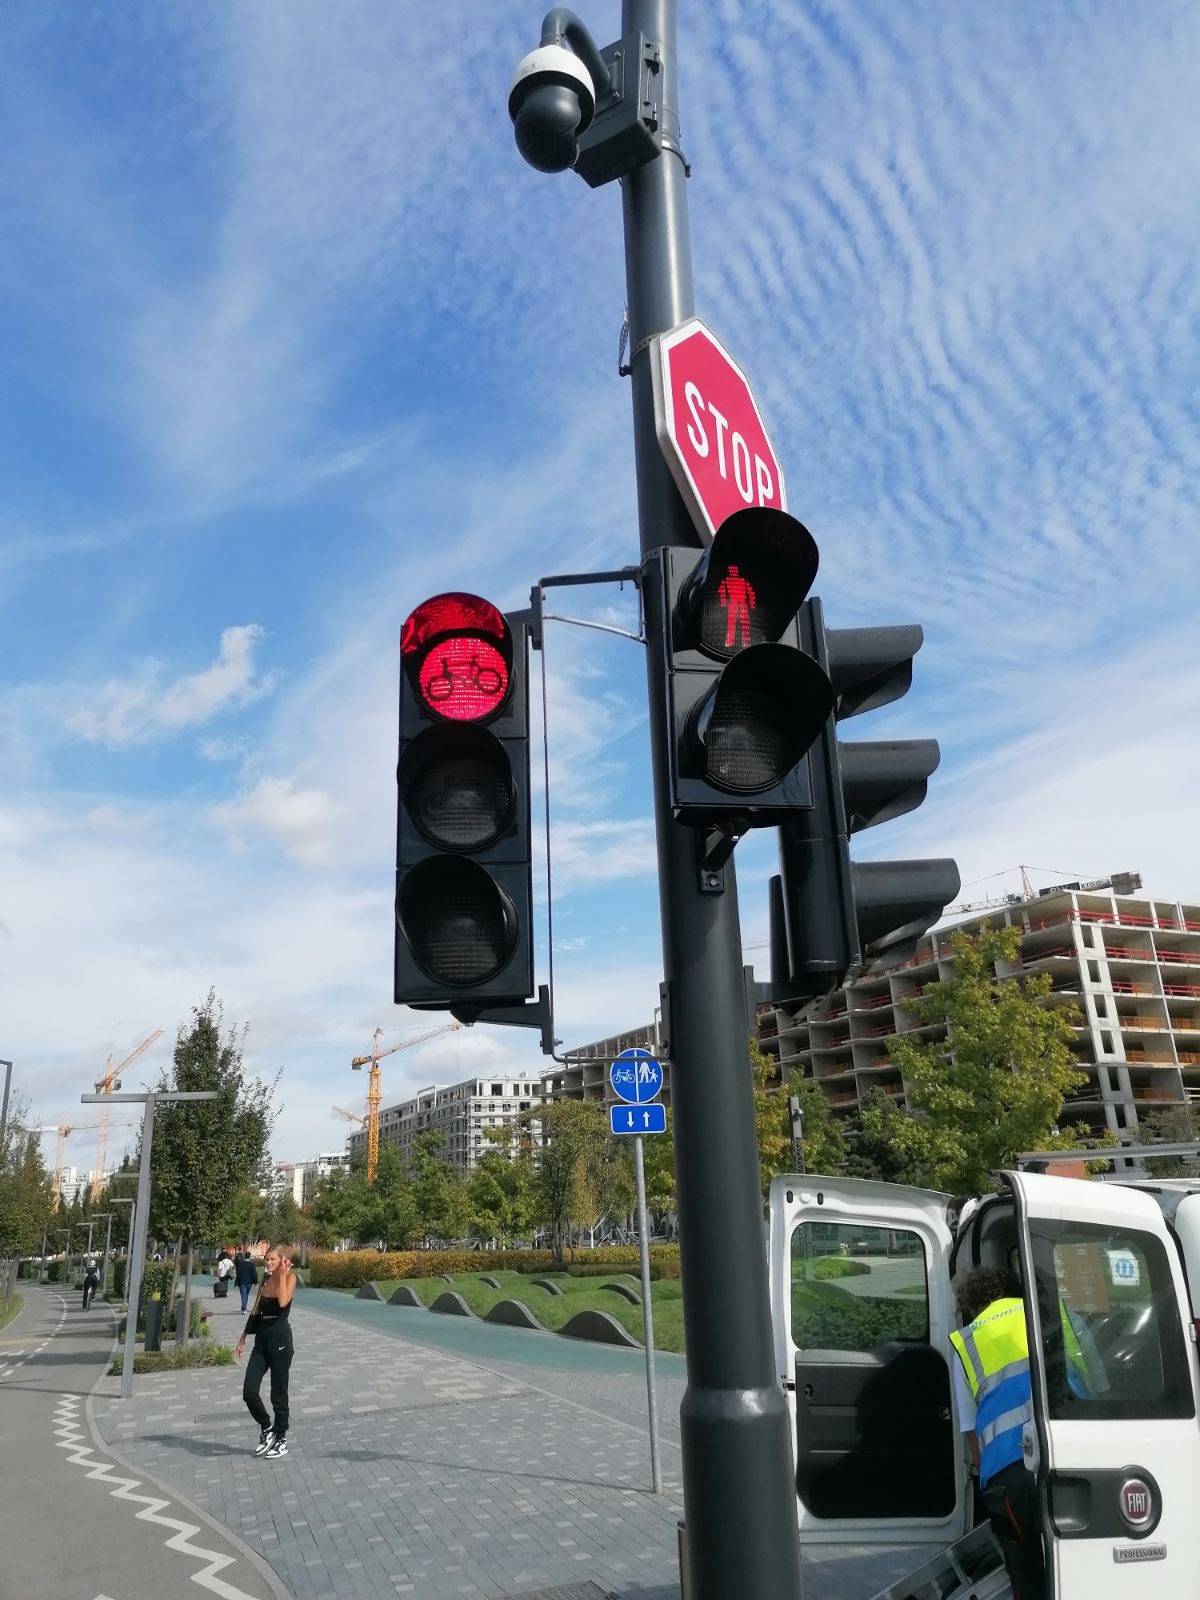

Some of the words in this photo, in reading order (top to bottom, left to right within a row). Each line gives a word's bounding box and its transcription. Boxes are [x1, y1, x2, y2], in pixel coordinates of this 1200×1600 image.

[684, 381, 774, 507] STOP
[1128, 1493, 1146, 1512] FIAT
[1120, 1548, 1164, 1558] PROFESSIONAL
